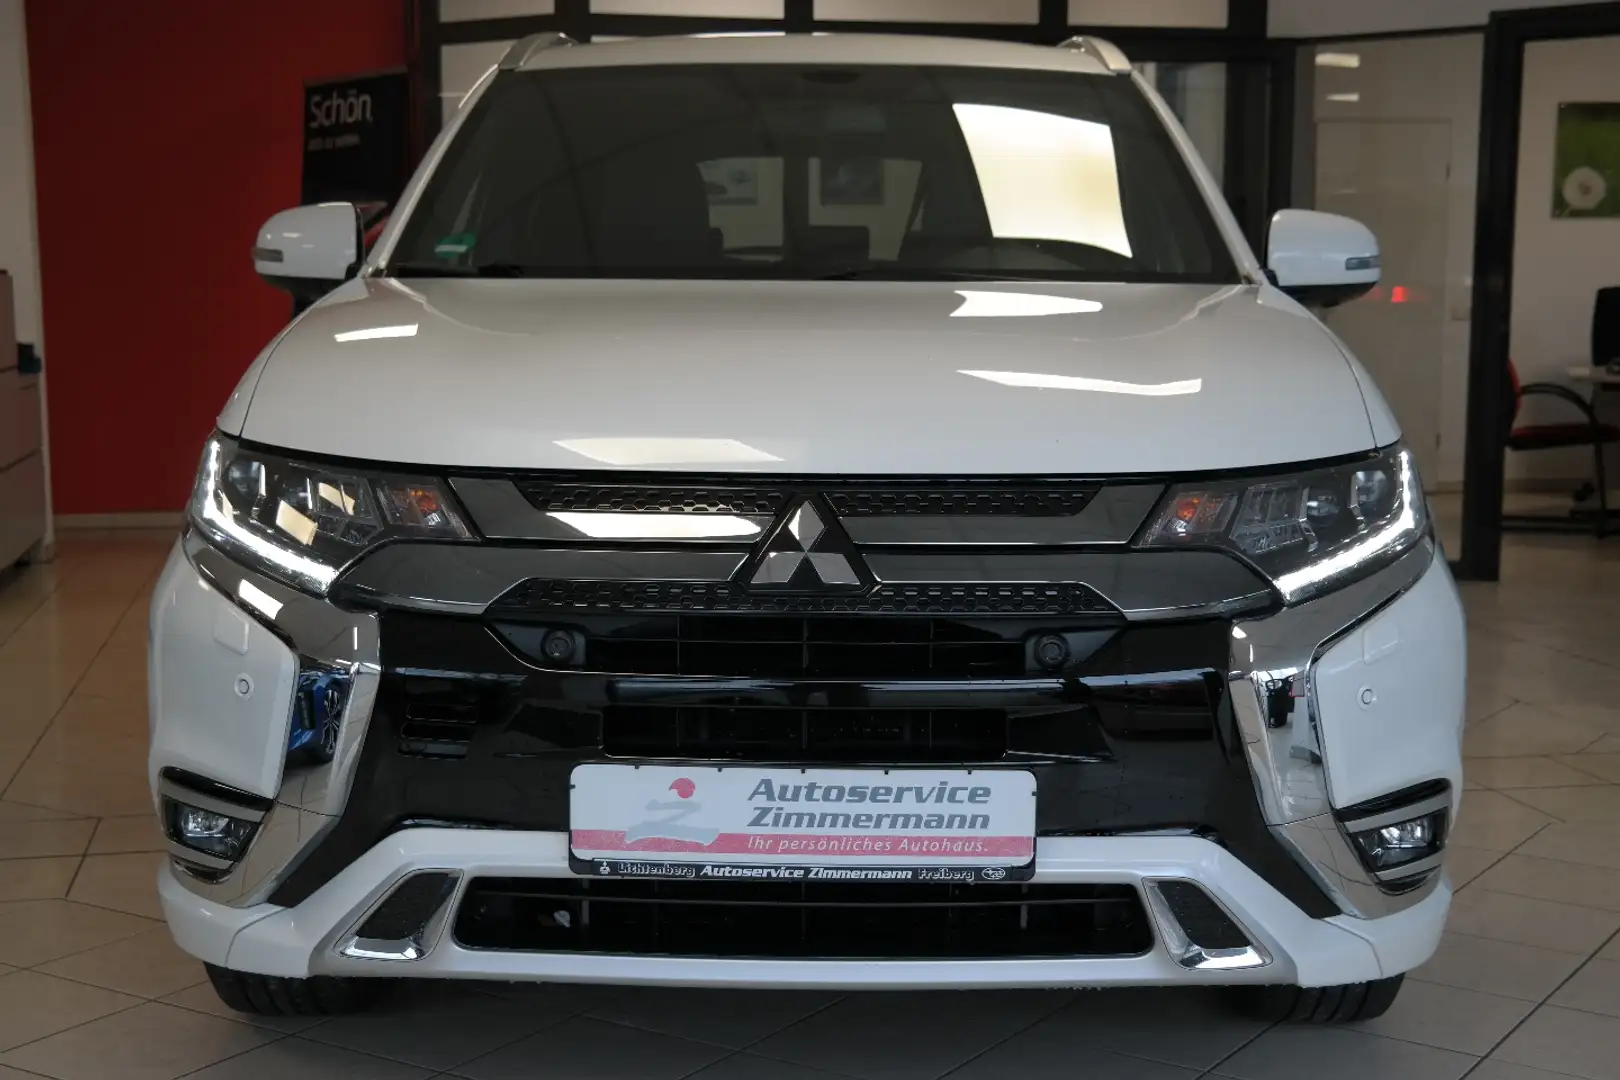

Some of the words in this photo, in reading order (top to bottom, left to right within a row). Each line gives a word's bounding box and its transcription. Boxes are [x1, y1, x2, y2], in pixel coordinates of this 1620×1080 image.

[747, 778, 991, 804] Autoservice
[746, 806, 990, 830] Zimmermann
[747, 835, 773, 850] Ihr
[778, 836, 892, 853] persönliches
[900, 839, 989, 853] Autohaus.
[617, 861, 696, 878] Lichtenberg
[700, 864, 804, 878] Autoservice
[807, 867, 912, 879] Zimmermann
[917, 867, 976, 881] Freiberg
